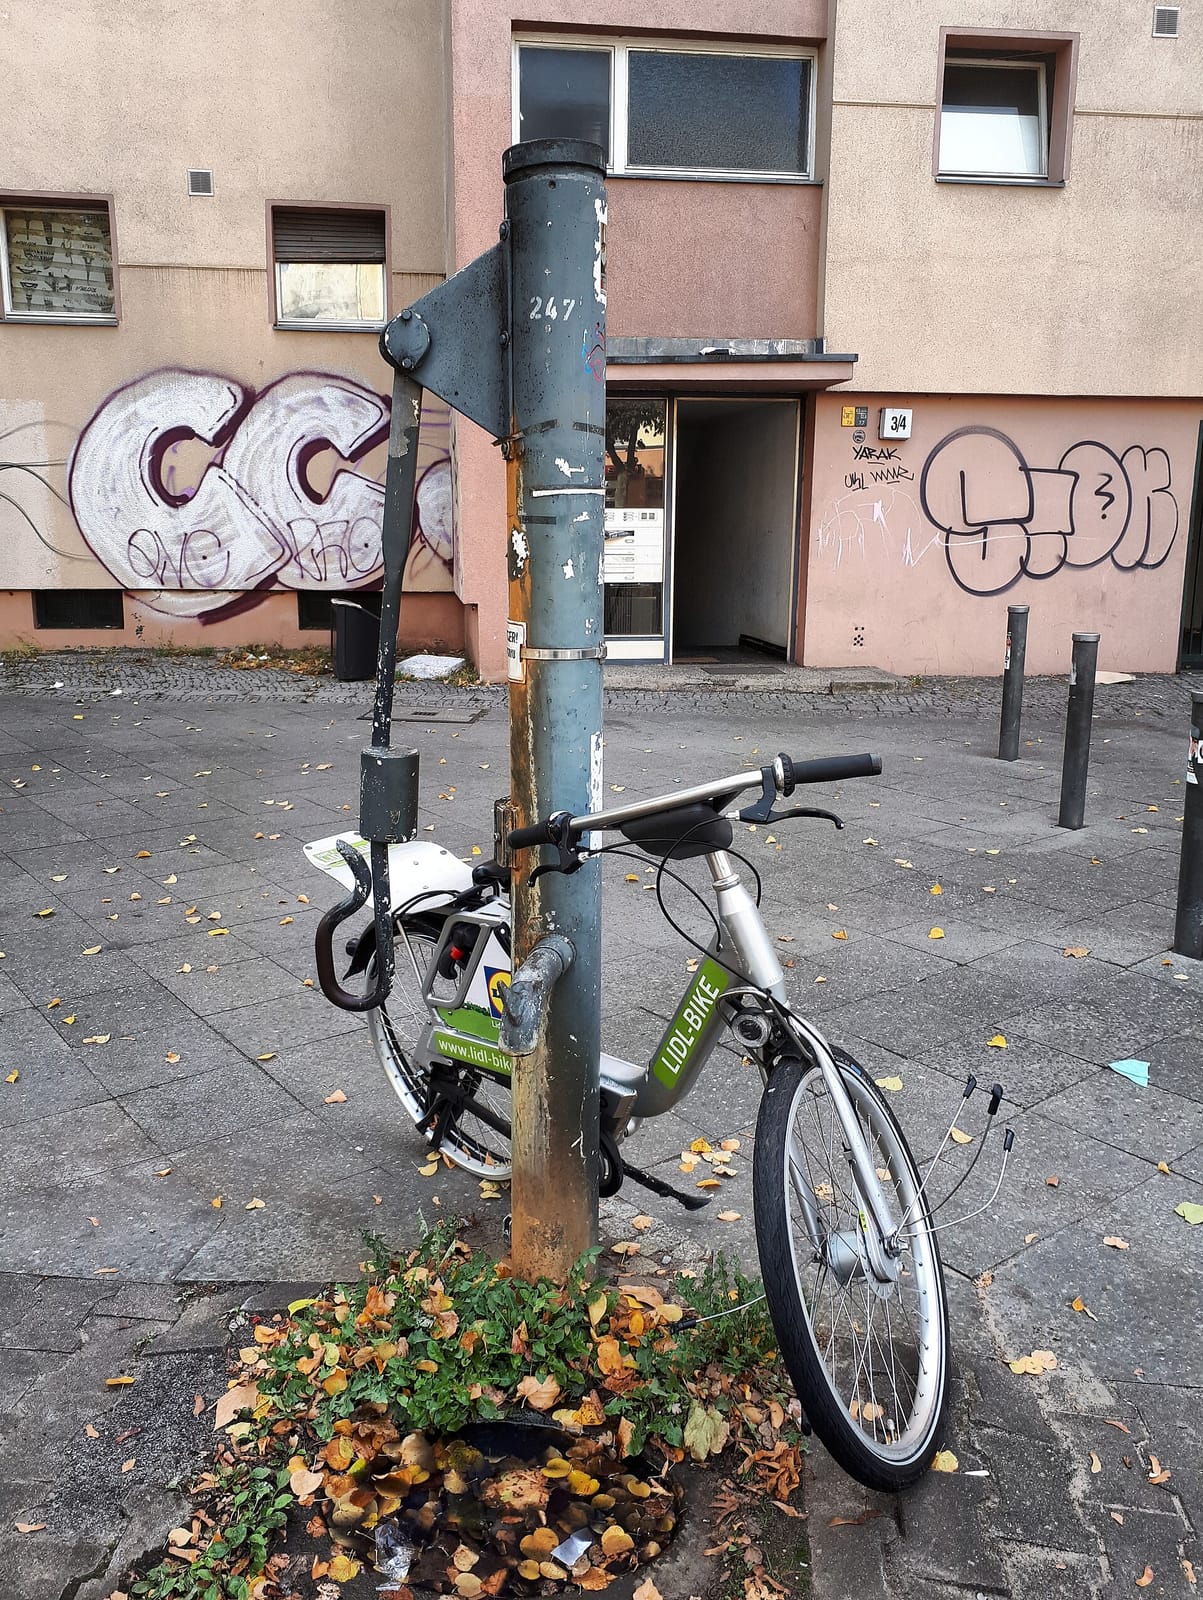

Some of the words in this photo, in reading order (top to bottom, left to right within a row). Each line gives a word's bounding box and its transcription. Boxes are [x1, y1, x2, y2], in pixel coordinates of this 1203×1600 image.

[529, 296, 576, 321] 247
[891, 414, 907, 432] 3/4
[661, 974, 720, 1074] LIDL-BIKE
